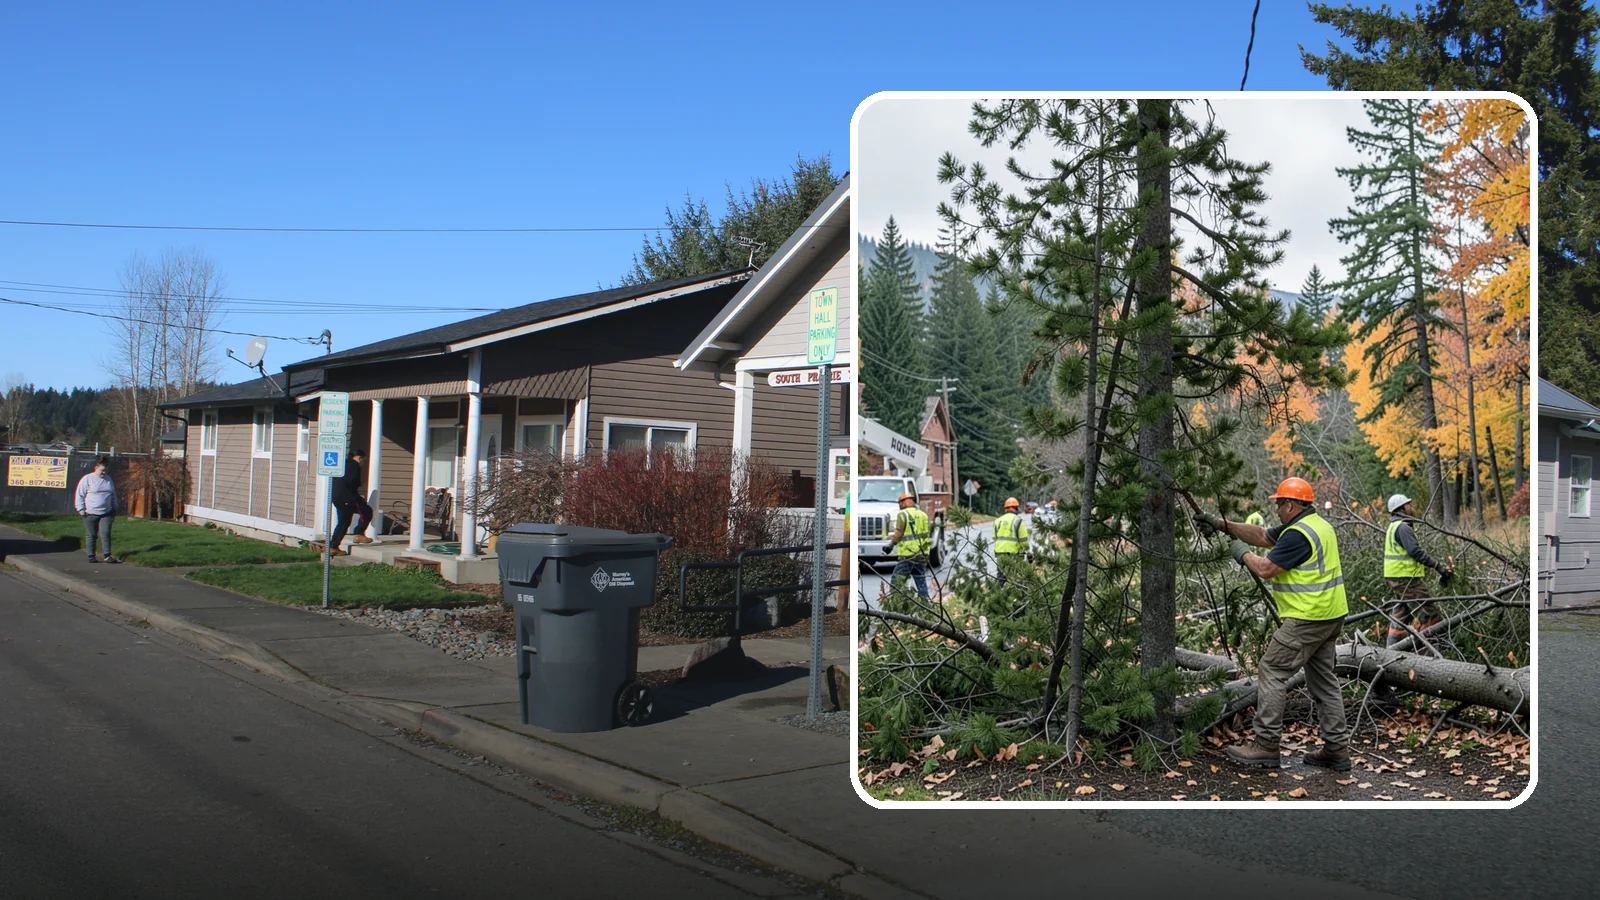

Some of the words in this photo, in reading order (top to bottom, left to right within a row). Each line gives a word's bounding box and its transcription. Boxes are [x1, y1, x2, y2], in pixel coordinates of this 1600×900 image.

[815, 295, 833, 308] TOWN
[814, 312, 831, 324] HALL
[810, 326, 836, 341] PARKING
[813, 344, 831, 357] ONLY
[775, 373, 801, 384] SOUTH
[807, 370, 842, 382] PRIE
